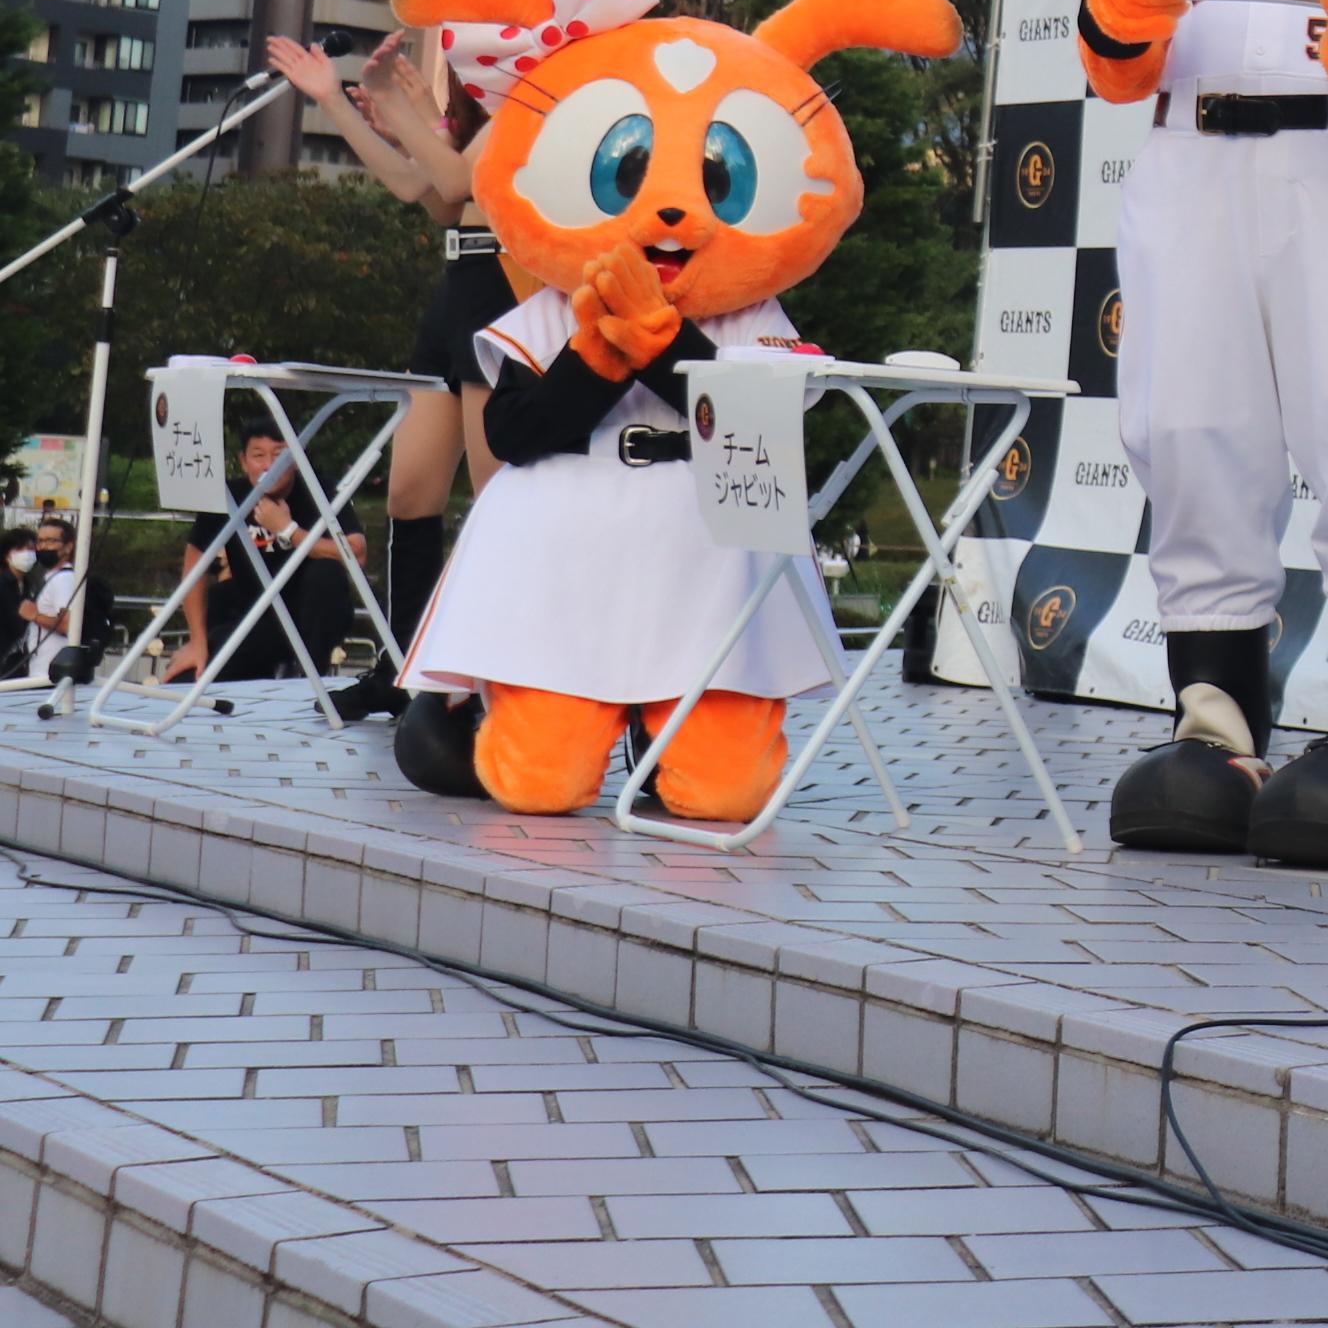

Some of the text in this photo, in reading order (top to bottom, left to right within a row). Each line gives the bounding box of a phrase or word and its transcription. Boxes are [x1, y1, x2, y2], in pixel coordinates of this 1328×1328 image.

[1019, 16, 1070, 42] GIANTS
[1000, 310, 1052, 334] GIANTS
[173, 422, 202, 446] チーム
[723, 433, 770, 467] チーム
[166, 451, 214, 478] ヴィーナス
[1075, 461, 1130, 488] GIANTS
[714, 471, 786, 511] ジャビット
